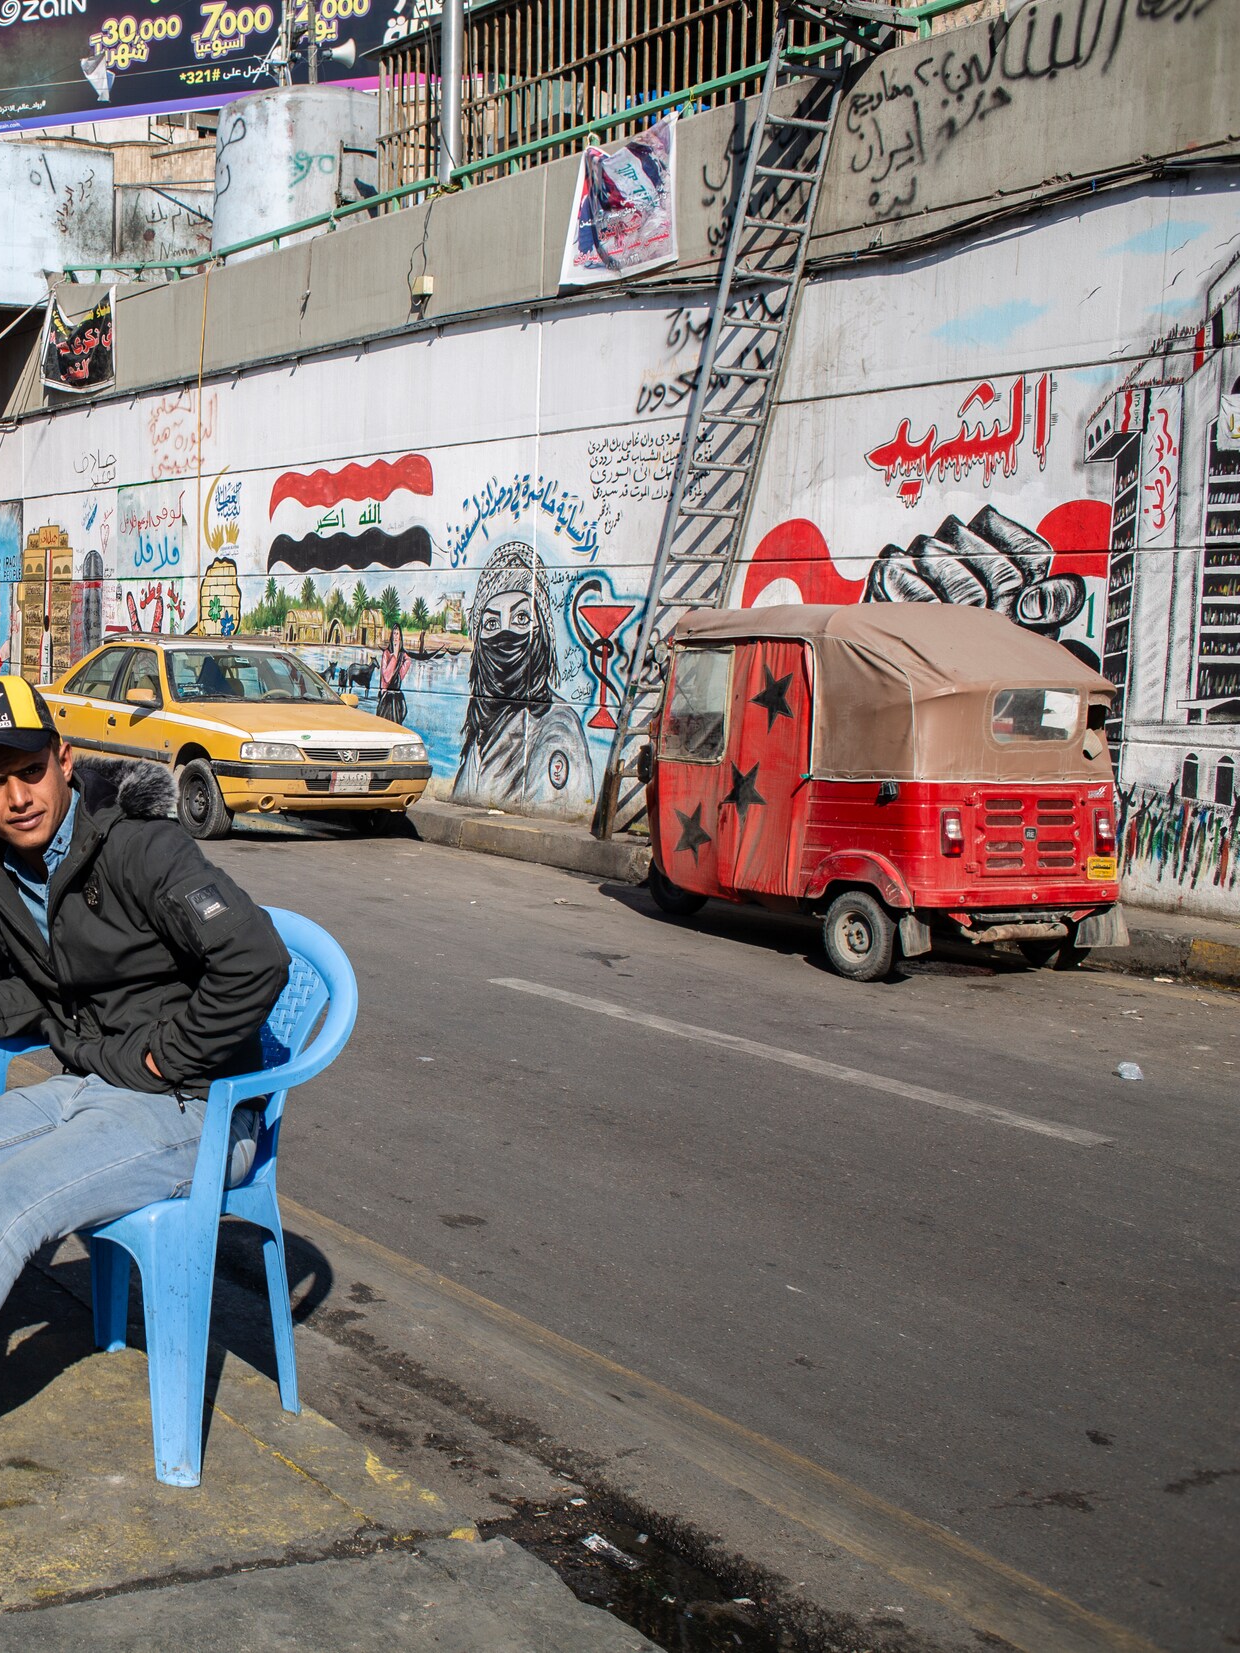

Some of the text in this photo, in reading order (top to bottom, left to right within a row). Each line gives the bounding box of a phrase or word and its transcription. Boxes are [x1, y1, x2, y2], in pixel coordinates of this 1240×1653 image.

[102, 17, 181, 46] 30,000
[201, 3, 272, 43] 7,000
[315, 502, 381, 533] الله اكبر
[134, 535, 180, 572] فلافل
